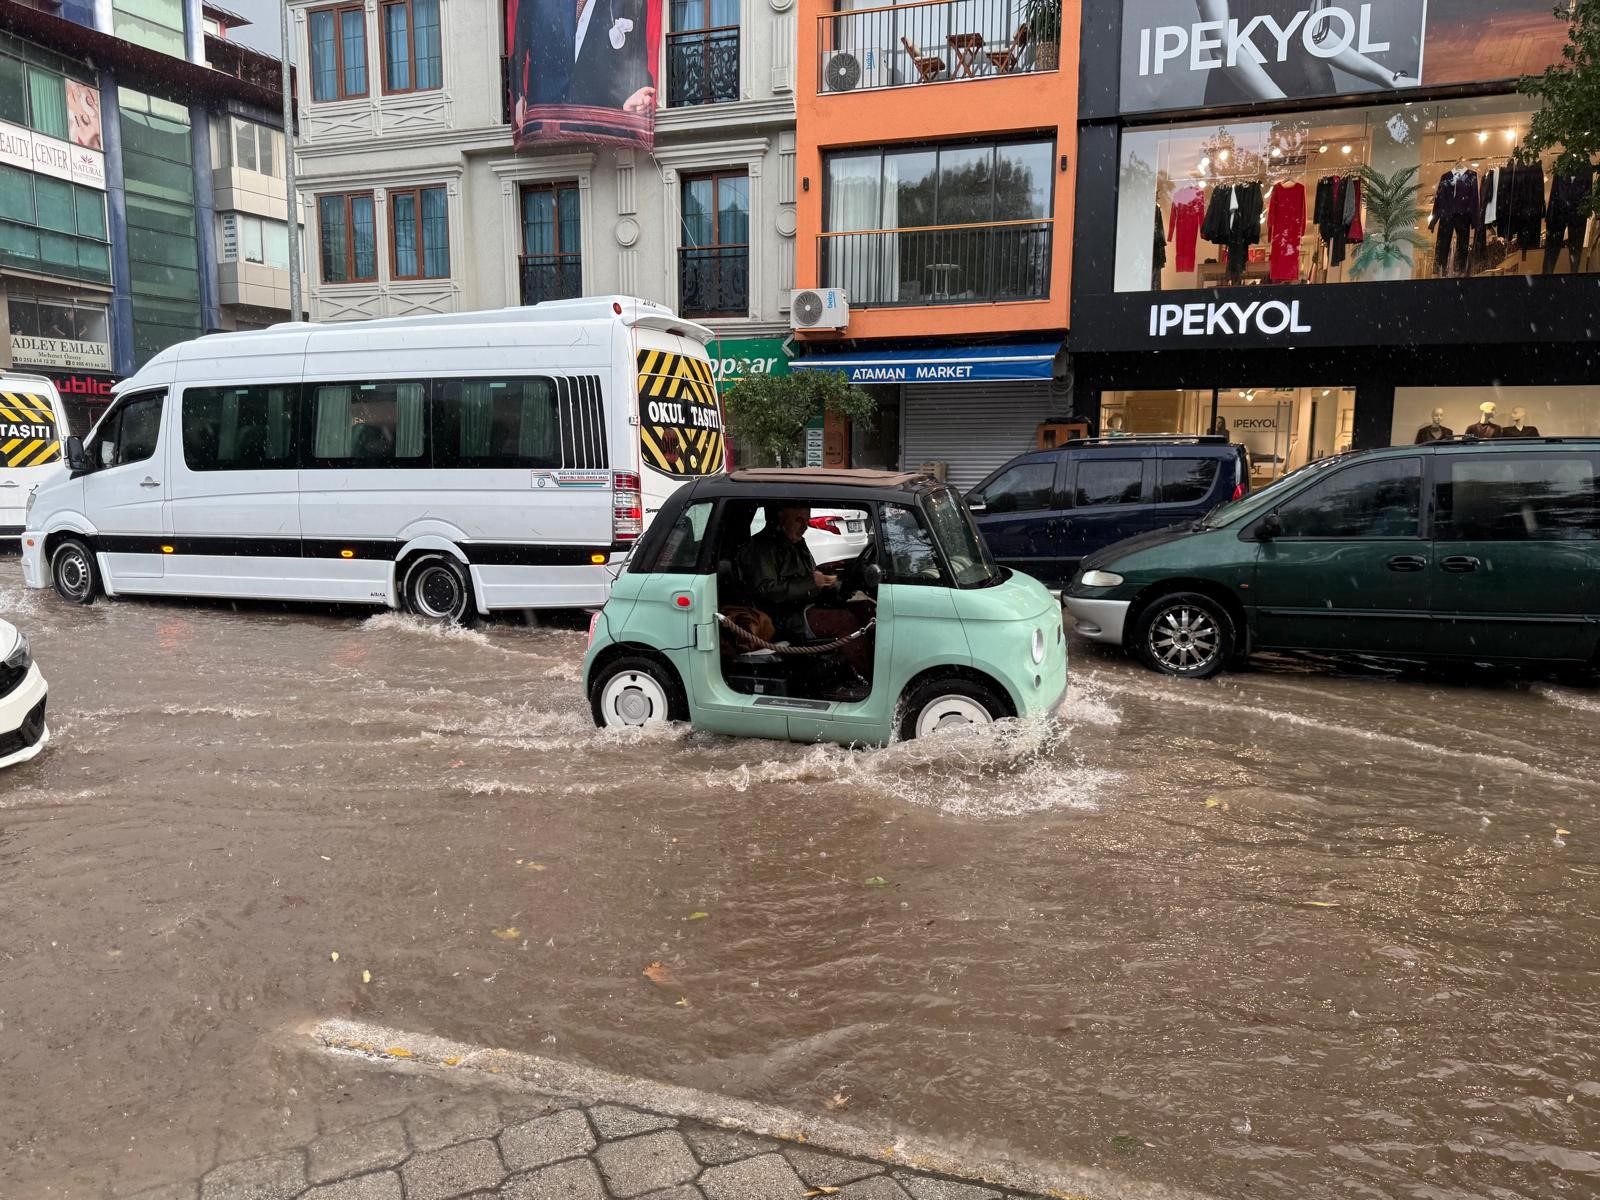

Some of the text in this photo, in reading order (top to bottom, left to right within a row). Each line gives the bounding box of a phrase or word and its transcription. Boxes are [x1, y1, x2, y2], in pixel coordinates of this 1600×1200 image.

[1139, 4, 1390, 76] IPEKYOL
[35, 142, 69, 170] CENTER
[73, 162, 103, 178] NATURAL
[1149, 300, 1312, 336] IPEKYOL
[12, 337, 105, 355] ADLEY EMLAK
[852, 366, 973, 380] ATAMAN MARKET
[648, 401, 686, 424] OKUL
[0, 423, 51, 439] TAŞITI
[1233, 418, 1278, 429] IPEKYOL
